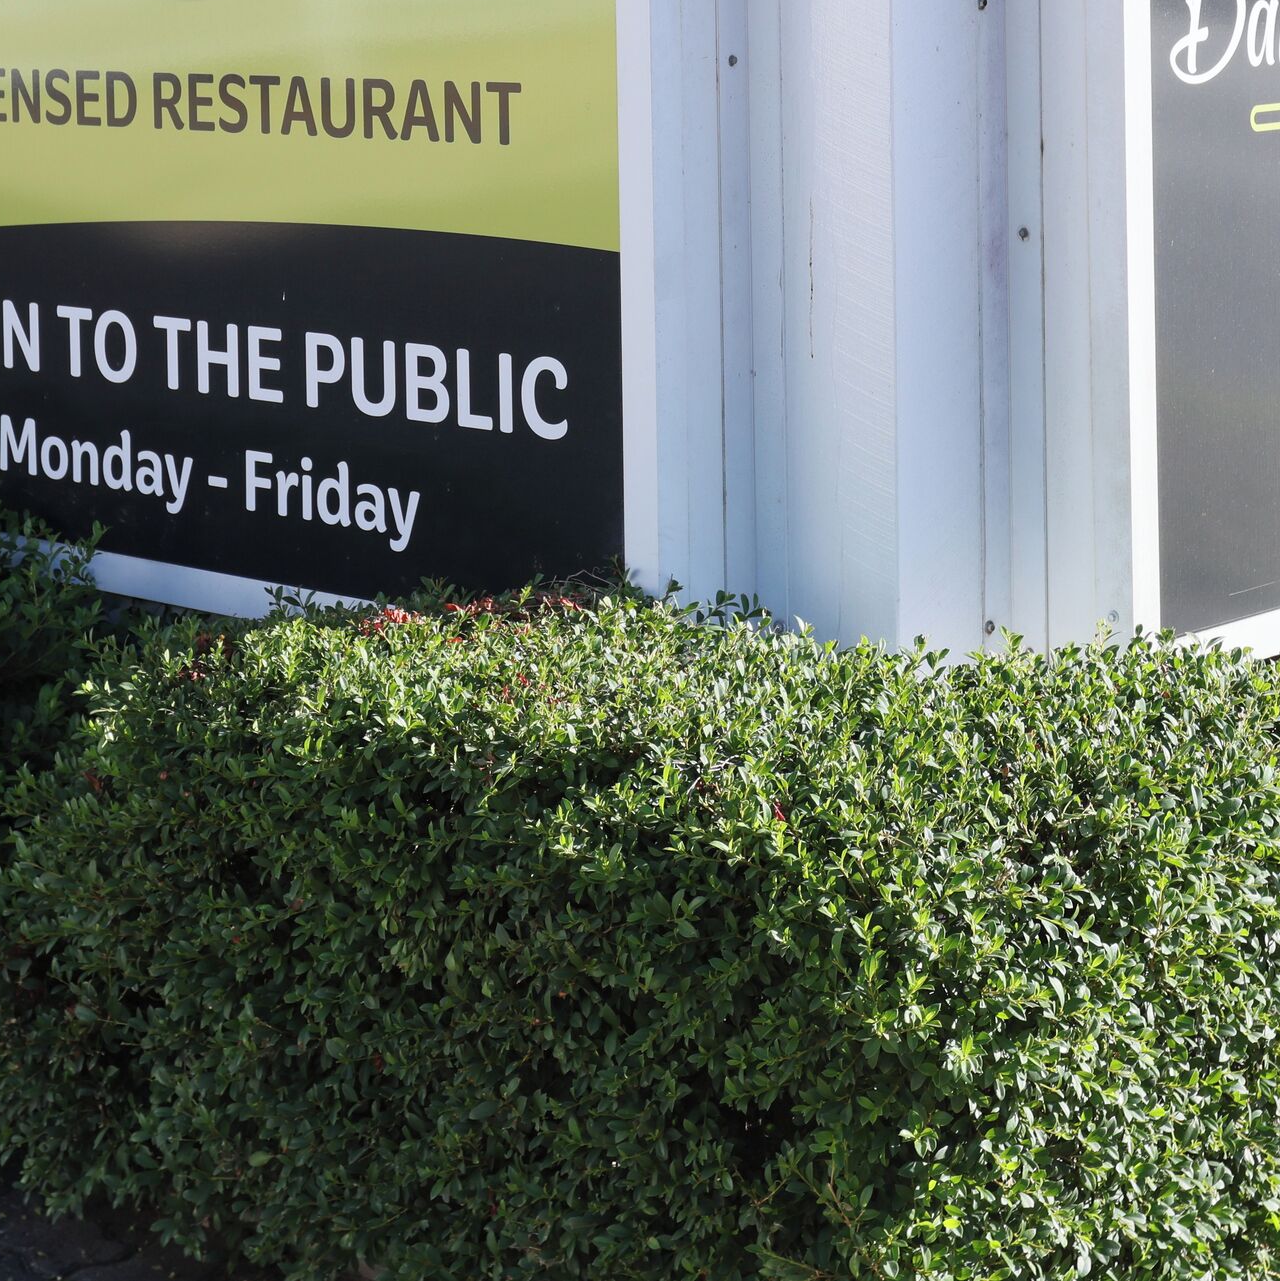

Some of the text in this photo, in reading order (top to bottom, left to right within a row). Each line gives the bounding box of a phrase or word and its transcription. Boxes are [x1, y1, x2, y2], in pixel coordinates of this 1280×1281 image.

[153, 73, 522, 146] RESTAURANT
[56, 305, 138, 384] TO
[153, 316, 285, 404] THE
[306, 333, 569, 441] PUBLIC
[0, 415, 194, 516] Monday
[246, 451, 421, 553] Friday
